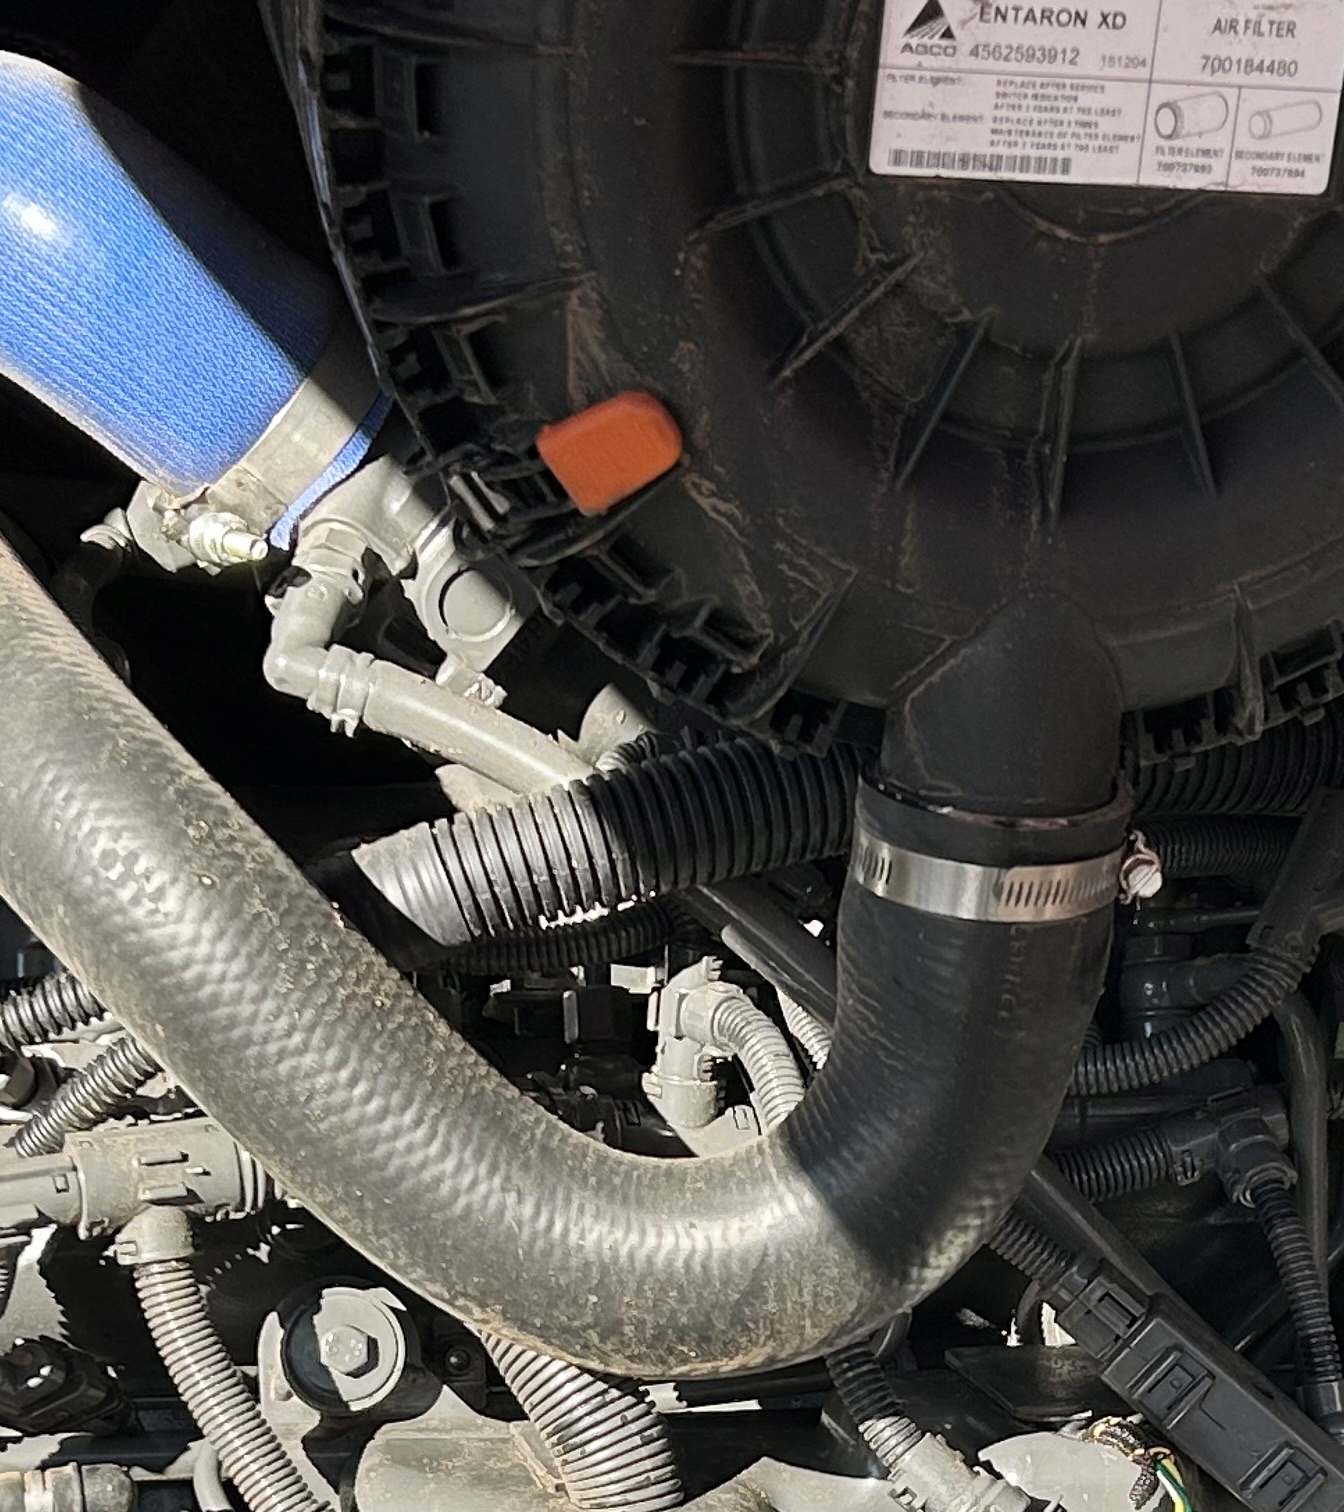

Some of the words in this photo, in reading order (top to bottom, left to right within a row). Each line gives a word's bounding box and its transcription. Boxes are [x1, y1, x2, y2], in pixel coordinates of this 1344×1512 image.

[1097, 11, 1127, 30] XD
[1211, 17, 1239, 36] AIR
[1243, 19, 1297, 38] FILTER
[900, 43, 957, 57] AGCO
